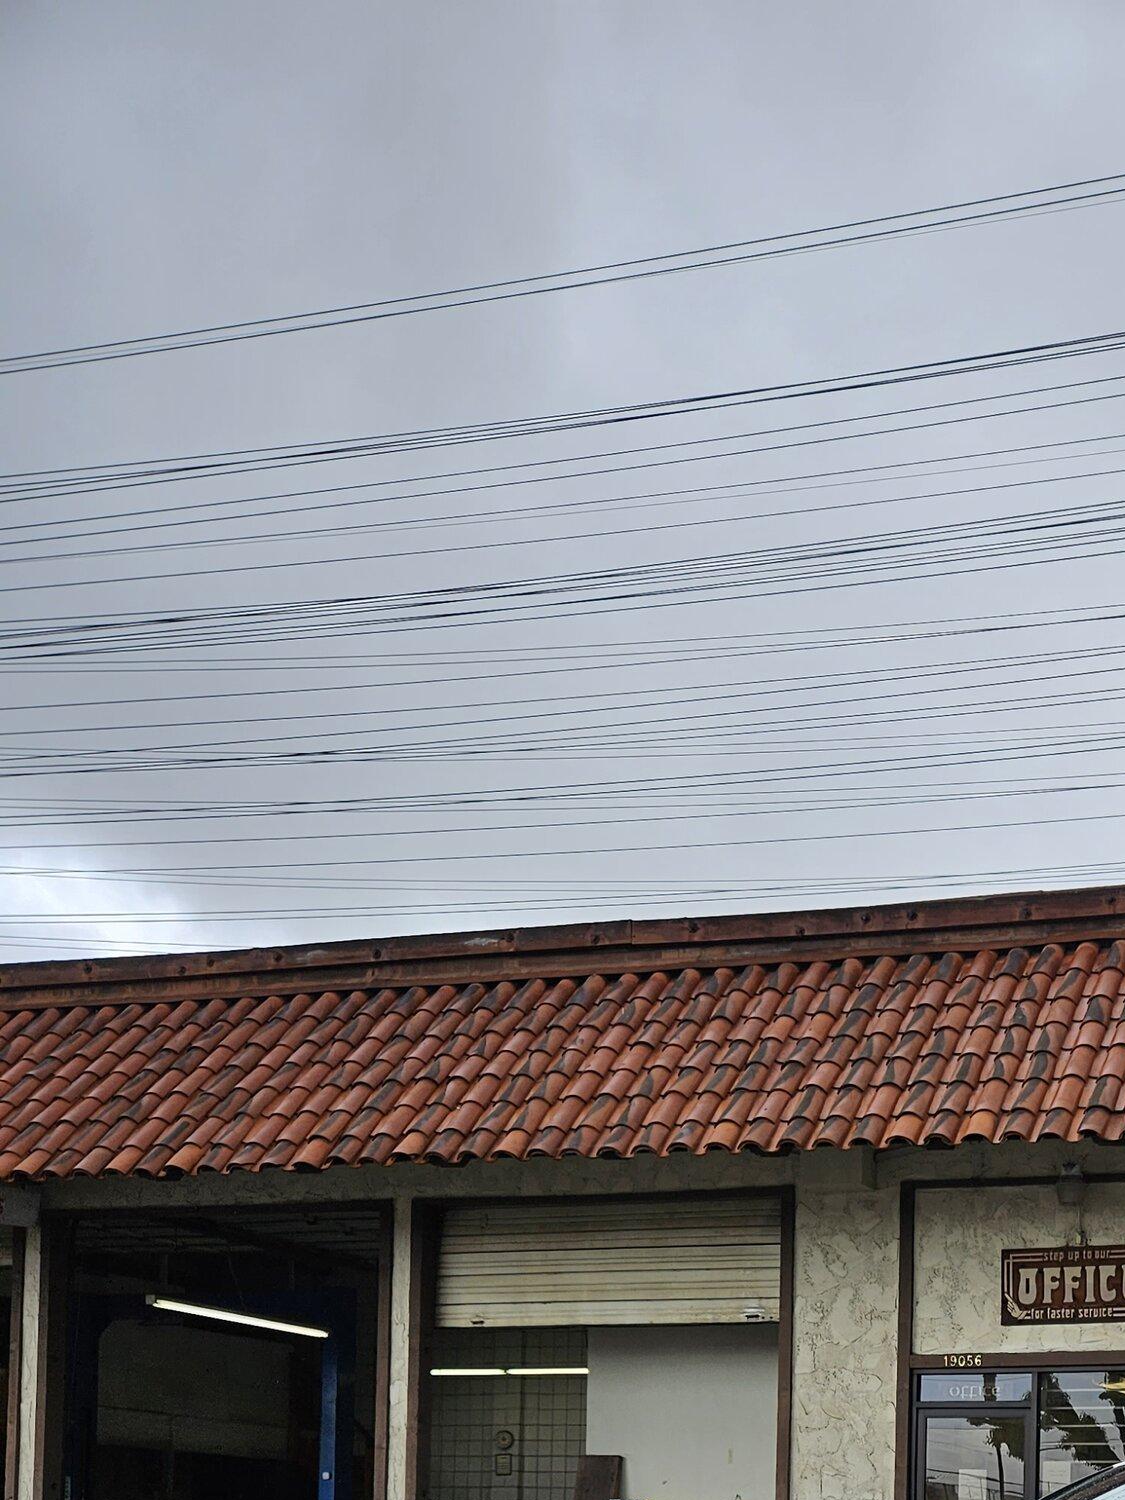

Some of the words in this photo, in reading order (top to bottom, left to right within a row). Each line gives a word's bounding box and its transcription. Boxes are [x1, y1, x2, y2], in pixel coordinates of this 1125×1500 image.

[1043, 1251, 1065, 1262] step
[1068, 1251, 1080, 1262] up
[1083, 1249, 1092, 1260] to
[1094, 1250, 1110, 1260] our
[1031, 1308, 1044, 1319] for
[1047, 1307, 1075, 1319] faster
[1078, 1307, 1113, 1318] service
[943, 1354, 982, 1367] 19056
